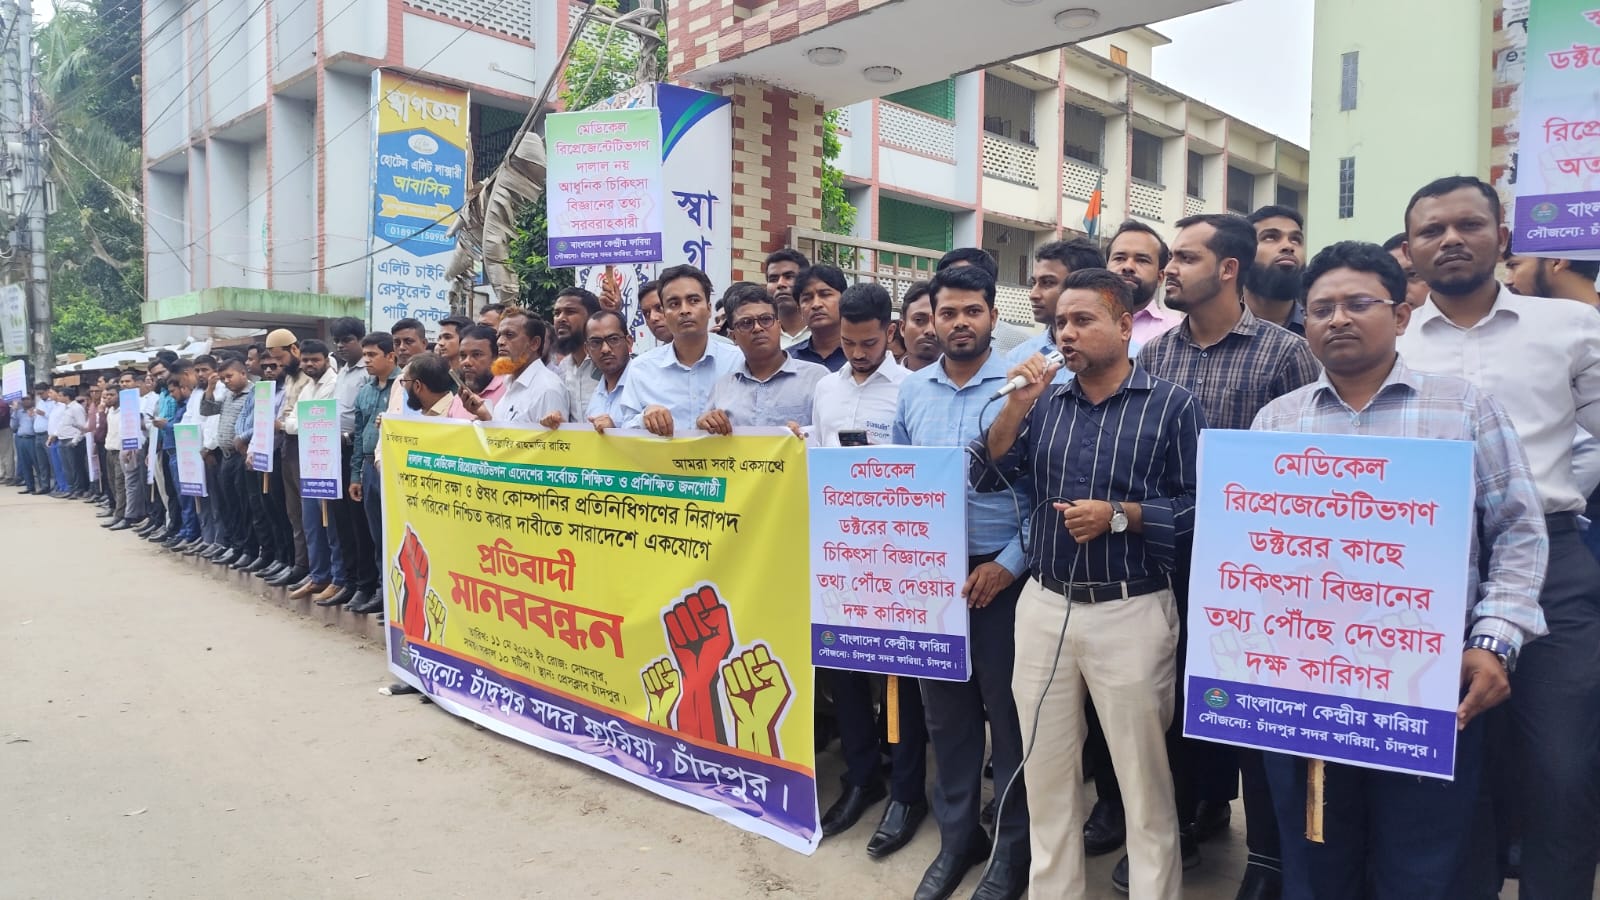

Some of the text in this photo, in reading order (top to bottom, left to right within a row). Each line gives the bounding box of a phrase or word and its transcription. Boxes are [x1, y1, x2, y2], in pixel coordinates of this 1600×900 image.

[384, 88, 462, 127] স্বাগতম
[577, 120, 628, 136] মেডিকেল
[556, 138, 650, 155] রিপ্রেজেন্টেটিভগণ
[380, 153, 408, 170] হোটেল
[411, 157, 432, 173] এলিট
[576, 160, 630, 173] দালাল নয়
[392, 174, 452, 198] আবাসিক
[558, 177, 648, 195] আধুনিক চিকিৎসা
[566, 197, 642, 212] বিজ্ঞানের তথ্য
[570, 214, 639, 230] সরবরাহকারী
[569, 239, 601, 249] বাংলাদেশ
[378, 258, 410, 276] এলিট
[378, 281, 431, 301] রেস্টুরেন্ট
[382, 302, 409, 319] পার্টি
[549, 440, 571, 452] রাহিম
[672, 457, 785, 474] আমরা সবাই একসাথে
[850, 458, 916, 479] মেডিকেল
[1274, 447, 1388, 481] মেডিকেল
[509, 467, 543, 481] এদেশের
[546, 467, 578, 484] সর্বোচ্চ
[581, 468, 614, 487] শিক্ষিত
[618, 477, 627, 488] ও
[631, 473, 675, 492] প্রশিক্ষিত
[678, 477, 721, 497] জনগোষ্ঠী
[420, 472, 442, 492] মর্যাদা
[444, 479, 462, 496] রক্ষা
[465, 484, 472, 498] ও
[475, 481, 498, 505] ঔষধ
[503, 488, 570, 512] কোম্পানির
[575, 492, 679, 526] প্রতিনিধিগণের
[685, 501, 741, 533] নিরাপদ
[823, 486, 946, 509] রিপ্রেজেন্টেটিভগণ
[1224, 483, 1439, 526] রিপ্রেজেন্টেটিভগণ
[406, 493, 712, 561] কর্ম পরিবেশ নিশ্চিত করার দাবীতে সারাদেশে একযোগে
[838, 516, 930, 540] ডক্টরের কাছে
[823, 541, 948, 567] চিকিৎসা বিজ্ঞানের
[1248, 528, 1406, 569] ডক্টরের কাছে
[477, 537, 576, 592] প্রতিবাদী
[816, 571, 956, 598] তথ্য পৌঁছে দেওয়ার
[1218, 561, 1435, 611] চিকিৎসা বিজ্ঞানের
[448, 570, 625, 659] মানববন্ধন
[842, 602, 928, 625] দক্ষ কারিগর
[839, 632, 951, 654] বাংলাদেশ কেন্দ্রীয় ফারিয়া
[1204, 607, 1445, 655] তথ্য পৌঁছে দেওয়ার
[498, 652, 509, 664] ১০
[591, 681, 620, 704] চাঁদপুর
[570, 663, 608, 685] সোমবার,
[1245, 651, 1393, 691] দক্ষ কারিগর
[1234, 693, 1428, 736] বাংলাদেশ কেন্দ্রীয় ফারিয়া
[470, 667, 526, 716] চাঁদপুর
[530, 695, 578, 734] সদর
[584, 714, 663, 773] ফারিয়া,
[671, 741, 770, 802] চাঁদপুর
[1198, 709, 1251, 729] সৌজন্যে:
[1256, 717, 1296, 739] চাঁদপুর
[1300, 729, 1329, 742] সদর
[1333, 732, 1379, 752] ফারিয়া,
[1384, 737, 1429, 758] চাঁদপুর
